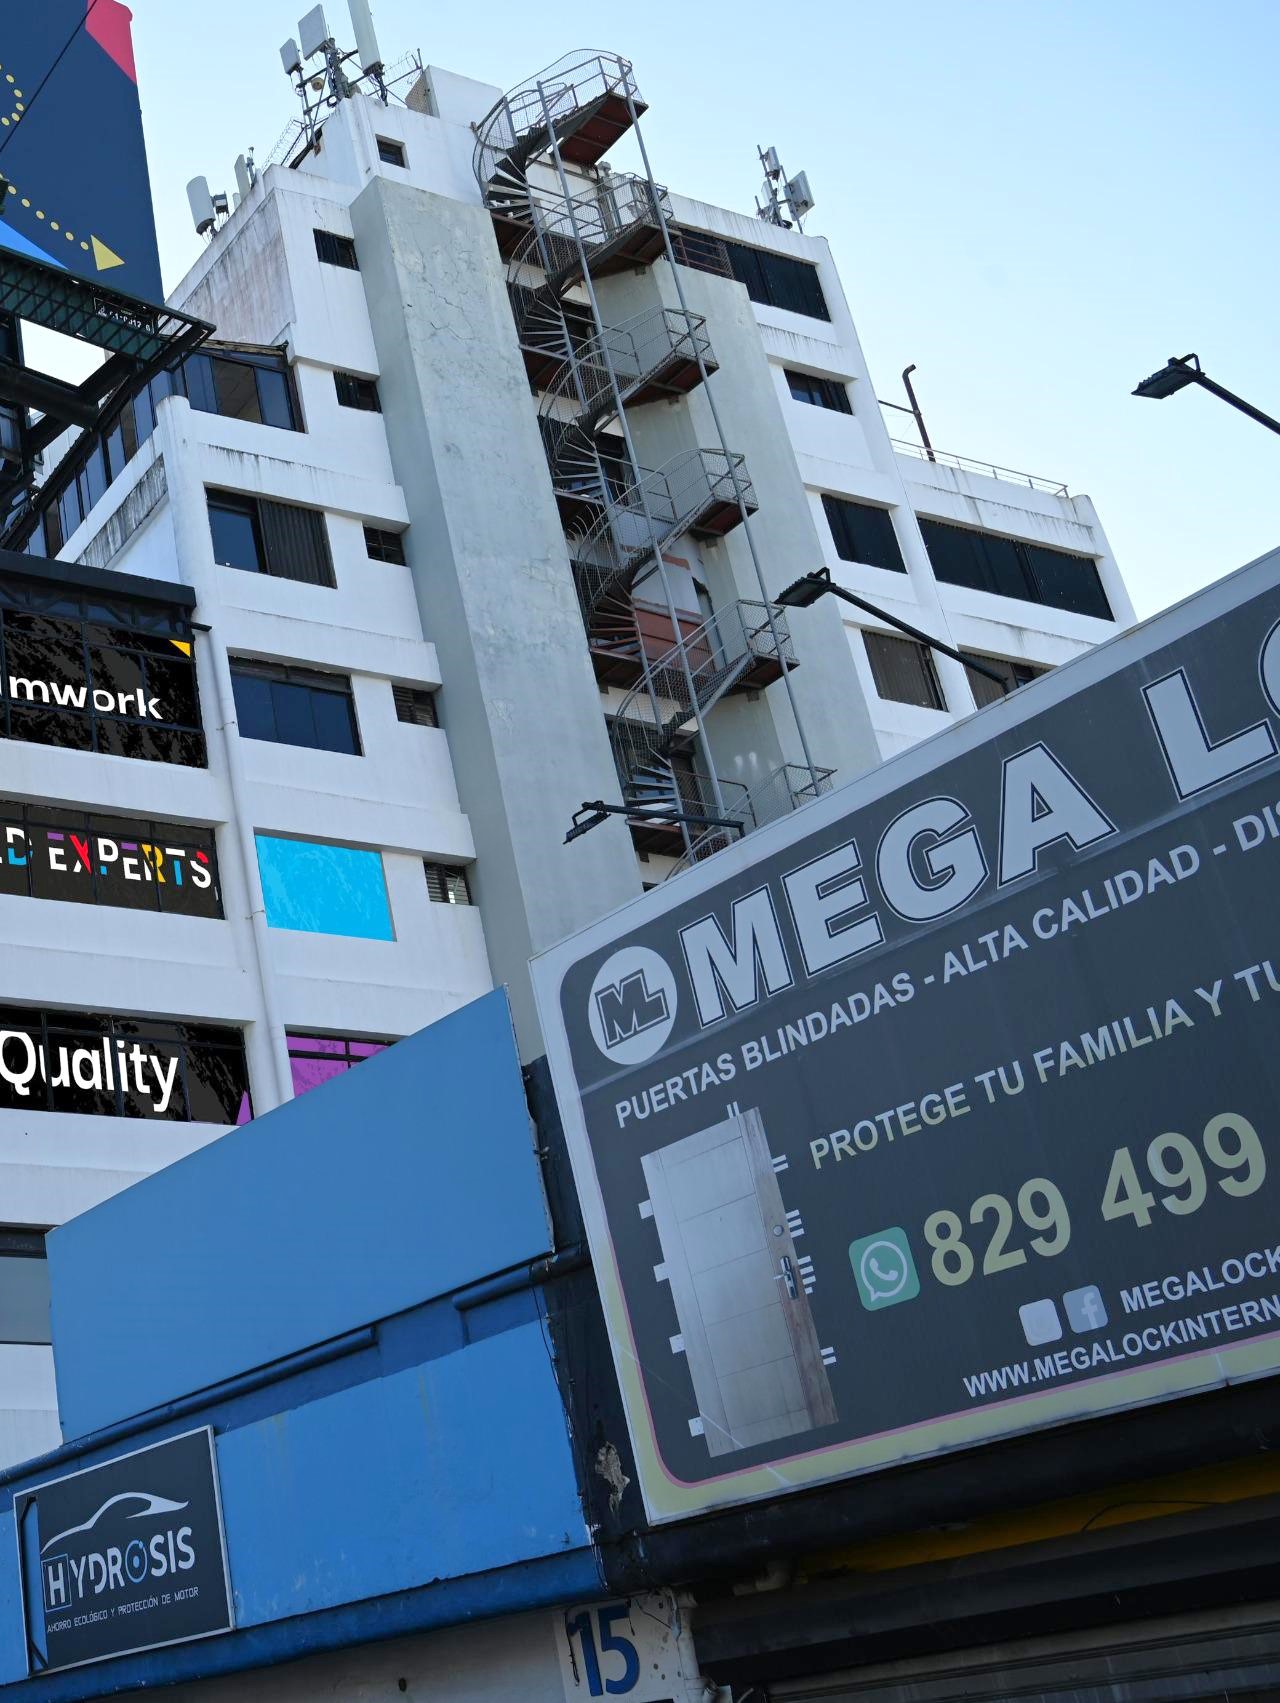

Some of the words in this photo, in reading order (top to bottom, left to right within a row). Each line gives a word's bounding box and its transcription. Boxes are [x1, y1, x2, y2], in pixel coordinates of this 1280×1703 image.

[47, 831, 212, 889] EXPERTS
[678, 741, 1117, 1029] MEGA
[1140, 617, 1280, 803] L
[615, 1053, 736, 1129] PUERTAS
[741, 972, 915, 1071] BLINDADAS
[942, 924, 1029, 984] ALTA
[1032, 844, 1200, 940] CALIDAD
[1232, 800, 1280, 852] DI
[809, 1082, 971, 1170] PROTEGE
[974, 1060, 1025, 1104] TU
[1032, 998, 1195, 1083] FAMILIA
[1193, 979, 1222, 1017] Y
[923, 1177, 1071, 1287] 829
[1101, 1112, 1267, 1228] 499
[47, 1526, 196, 1606] HYDROSIS
[47, 1619, 71, 1633] AHORRO
[110, 1608, 116, 1617] Y
[161, 1593, 171, 1605] DE
[174, 1586, 199, 1601] MOTOR
[567, 1605, 640, 1696] 15
